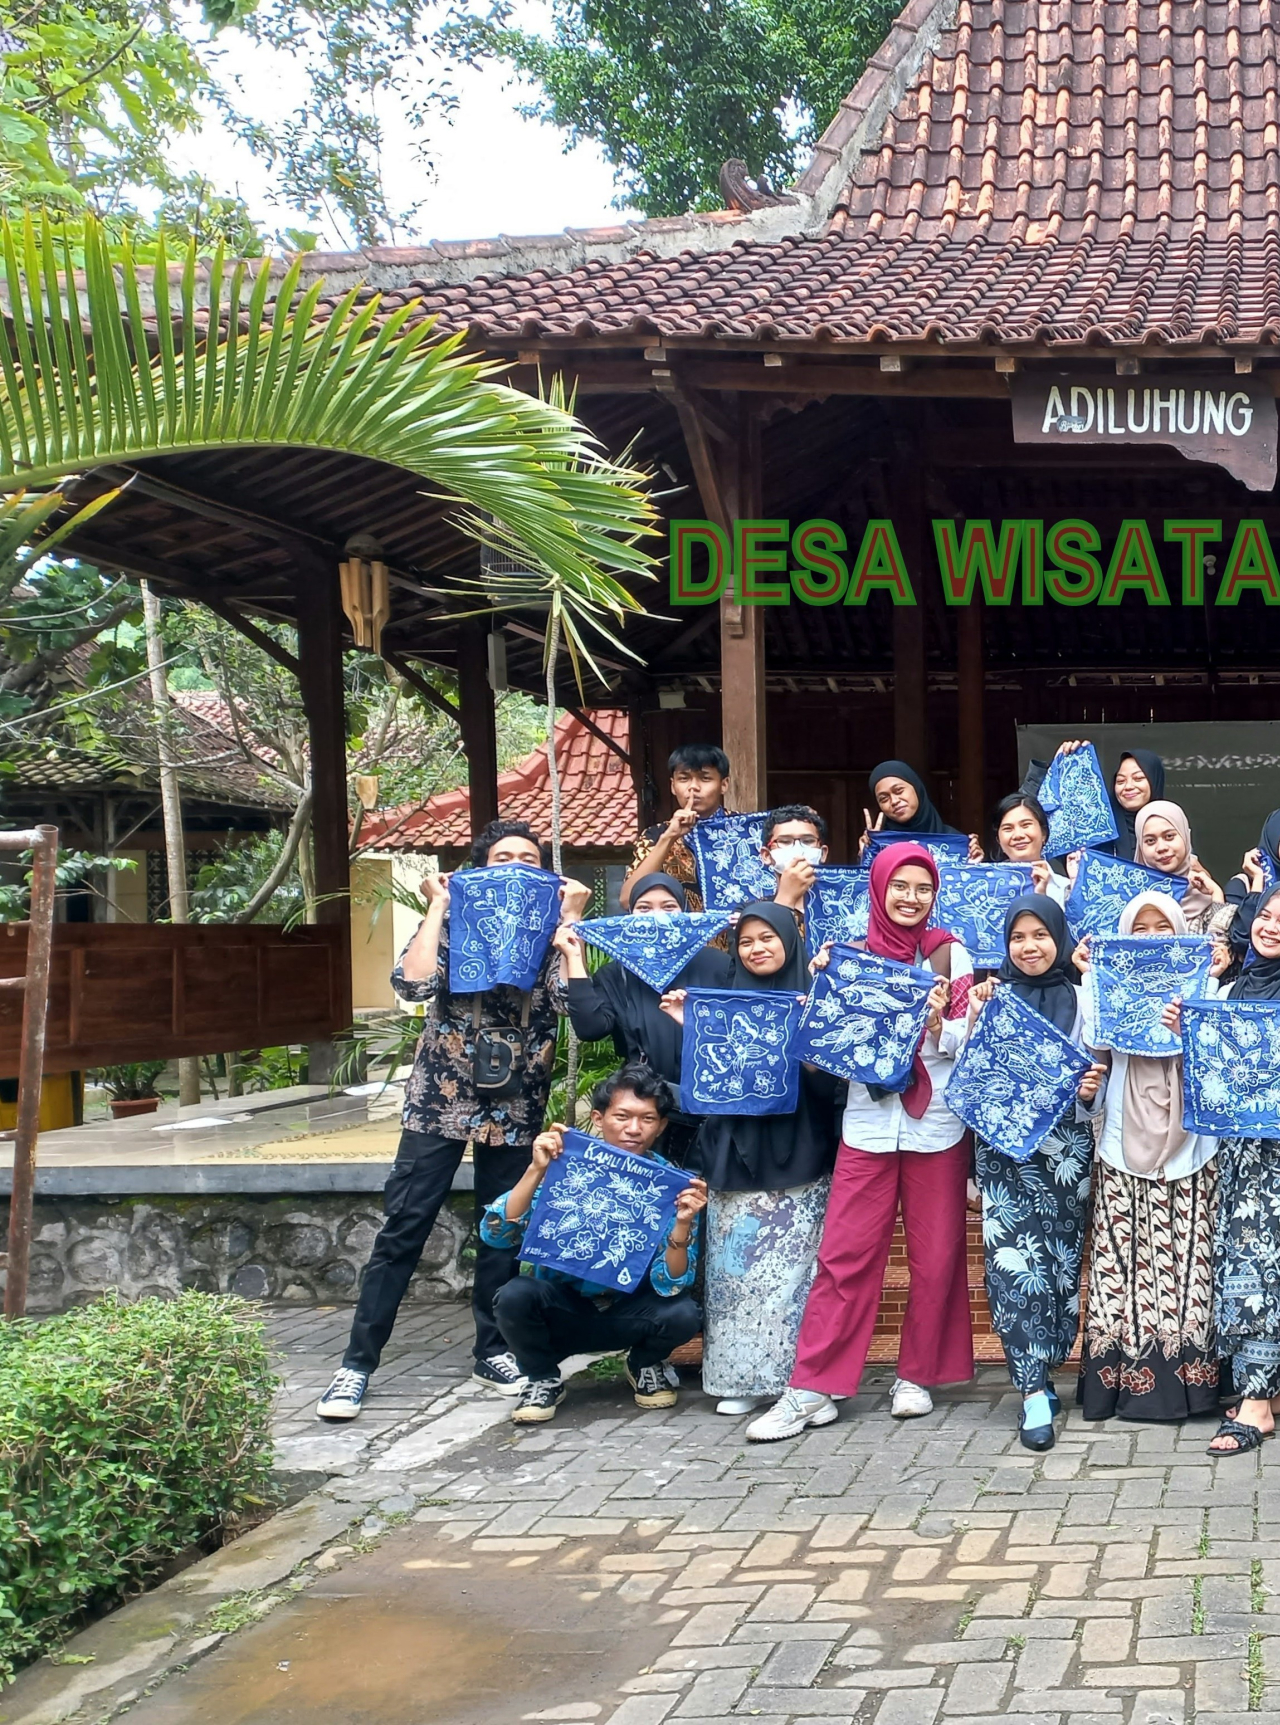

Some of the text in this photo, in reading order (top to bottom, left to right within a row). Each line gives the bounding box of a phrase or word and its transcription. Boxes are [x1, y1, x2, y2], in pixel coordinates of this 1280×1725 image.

[1041, 385, 1254, 436] ADILUHUNG
[811, 1053, 833, 1070] Batik
[583, 1141, 622, 1168] KAMU
